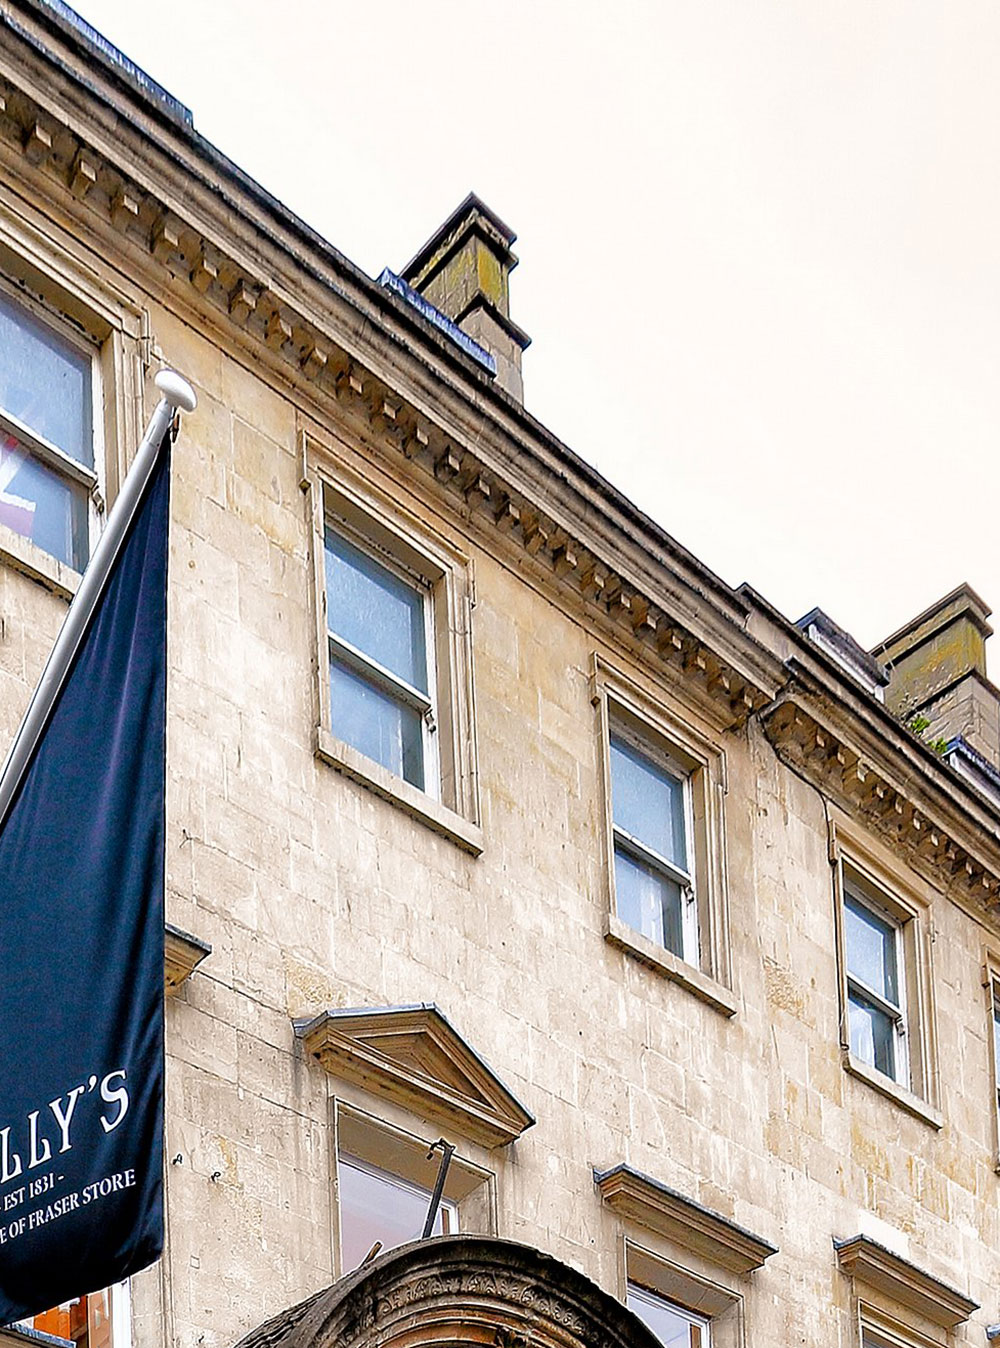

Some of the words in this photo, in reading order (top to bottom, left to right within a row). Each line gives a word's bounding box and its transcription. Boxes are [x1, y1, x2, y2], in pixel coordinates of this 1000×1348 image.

[3, 1182, 26, 1211] EST
[28, 1174, 55, 1199] 1831
[9, 1218, 27, 1239] OF
[28, 1194, 80, 1230] FRASER
[82, 1168, 137, 1205] STORE
